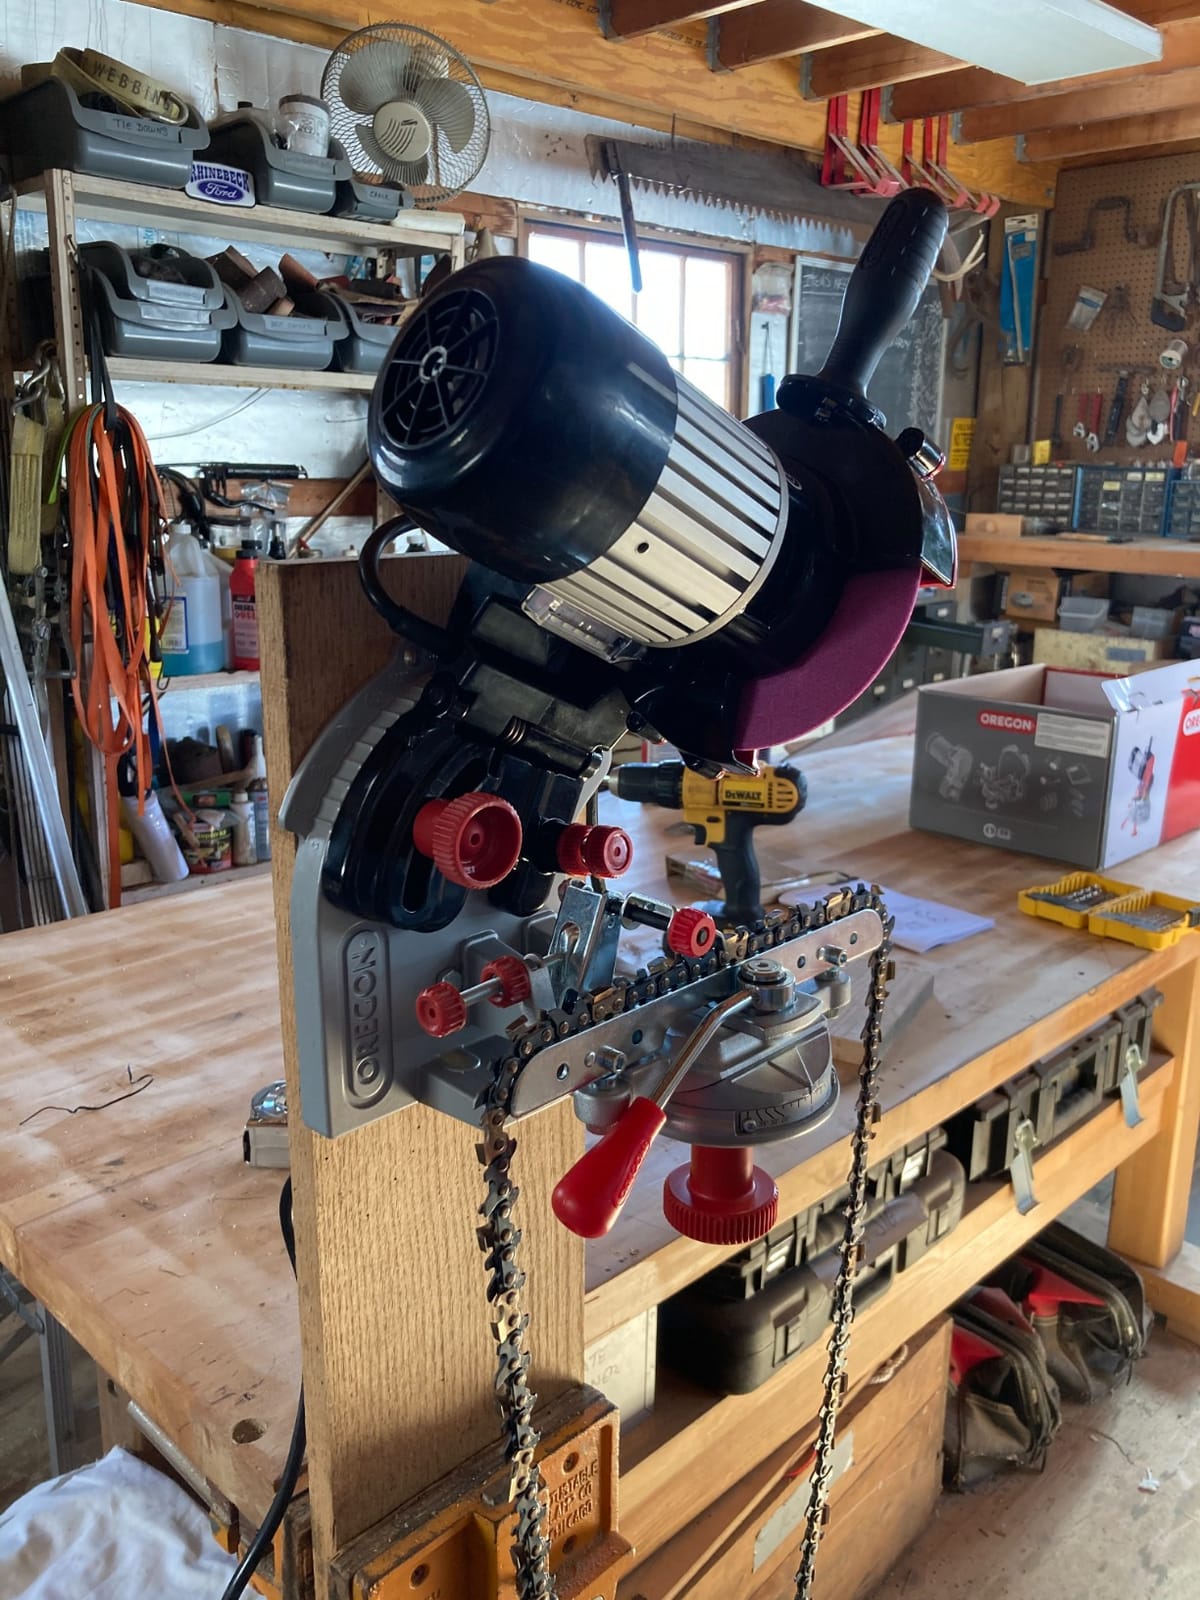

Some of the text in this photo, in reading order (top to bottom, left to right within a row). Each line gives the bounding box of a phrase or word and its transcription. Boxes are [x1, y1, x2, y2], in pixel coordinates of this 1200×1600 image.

[94, 61, 172, 112] WEBBING
[205, 182, 238, 199] Ford
[980, 712, 1032, 731] OREGON
[352, 945, 379, 1085] OREGON
